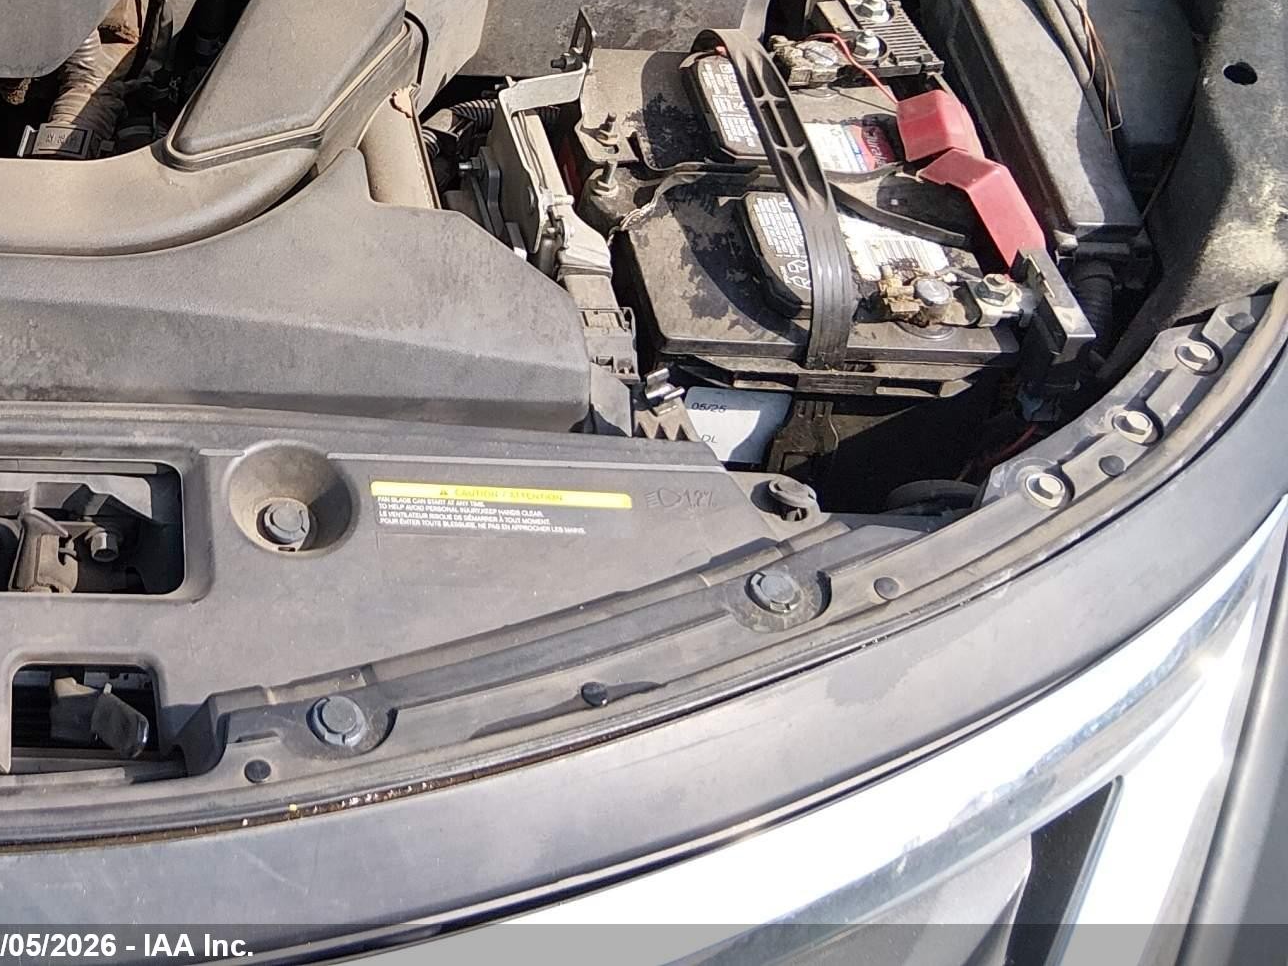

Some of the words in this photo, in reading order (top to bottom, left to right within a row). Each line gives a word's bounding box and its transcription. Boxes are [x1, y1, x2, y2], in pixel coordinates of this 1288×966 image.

[454, 489, 499, 498] CAUTION
[509, 492, 563, 501] ATTENTION
[425, 505, 458, 513] PERSONAL
